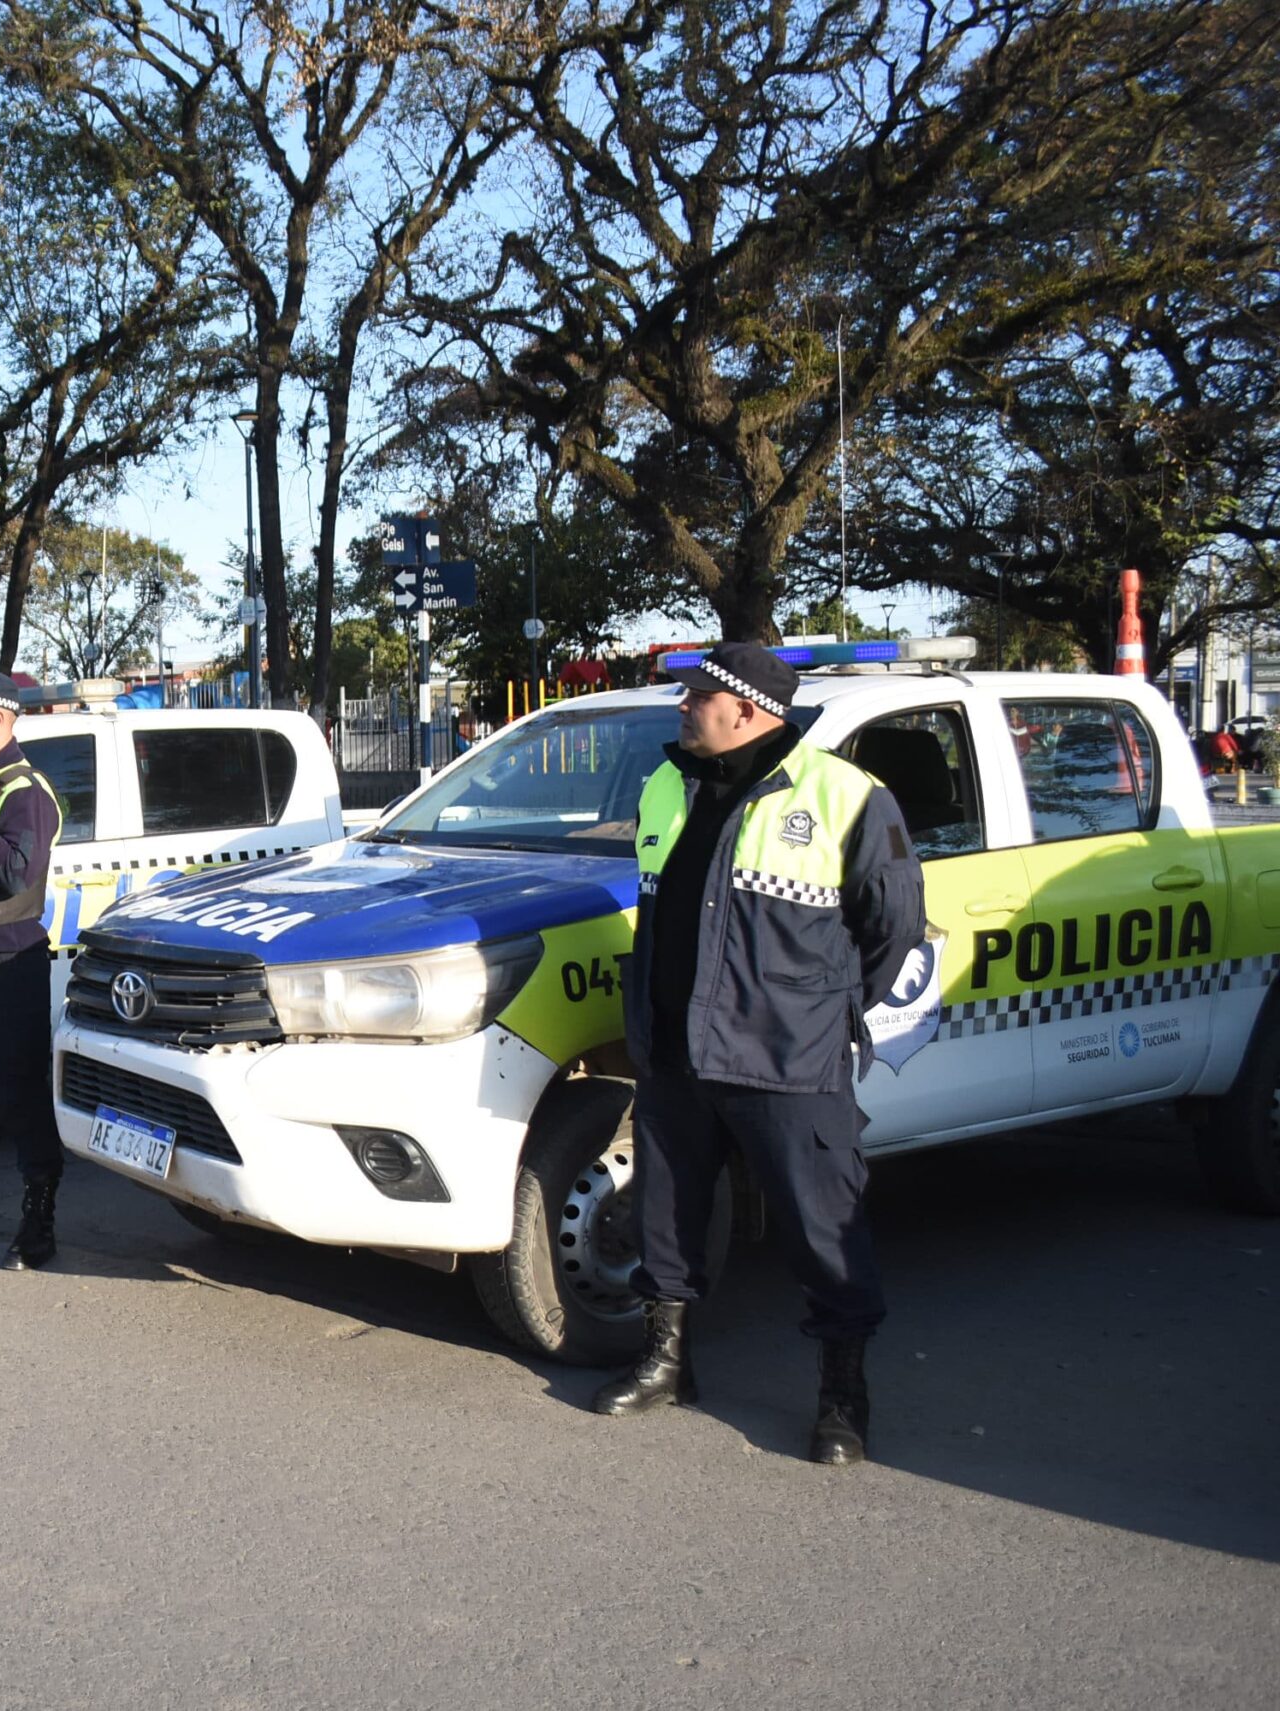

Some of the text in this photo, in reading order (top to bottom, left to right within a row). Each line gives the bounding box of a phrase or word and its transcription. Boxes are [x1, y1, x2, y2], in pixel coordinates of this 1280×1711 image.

[381, 522, 395, 538] Pje
[382, 537, 404, 551] Gelsi
[423, 567, 439, 579] Av.
[423, 582, 443, 594] San
[971, 900, 1211, 989] POLICIA
[891, 1014, 901, 1024] DE
[1141, 1017, 1180, 1033] GOBIERNO DE
[1060, 1032, 1109, 1049] MINISTERIO DE
[1067, 1046, 1110, 1063] SEGURIDAD
[92, 1122, 113, 1151] AE
[146, 1141, 167, 1171] UZ
